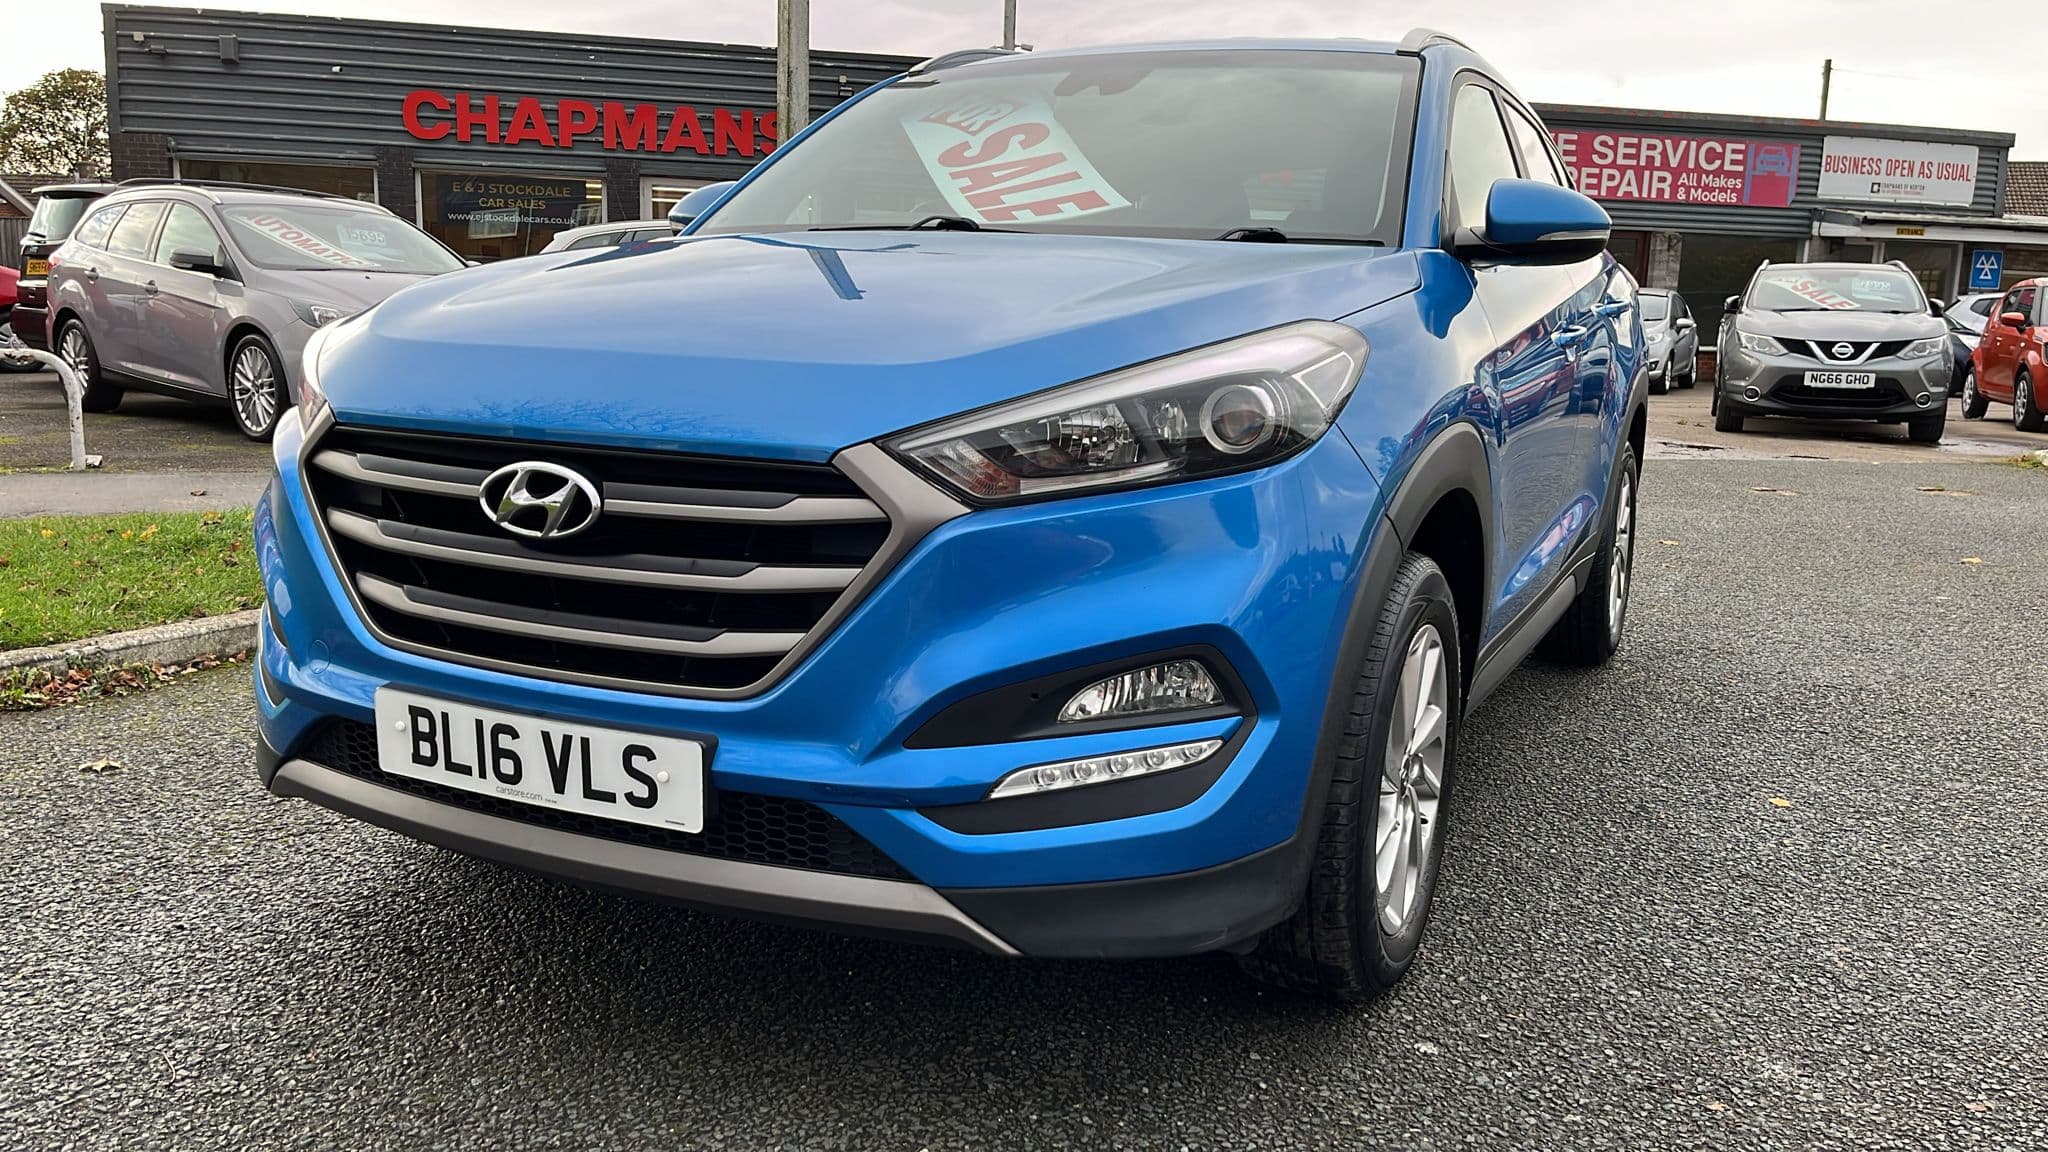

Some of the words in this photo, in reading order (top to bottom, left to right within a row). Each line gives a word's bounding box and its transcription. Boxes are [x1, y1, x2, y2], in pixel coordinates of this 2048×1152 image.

[1551, 133, 1578, 162] E
[1592, 135, 1745, 173] SERVICE
[938, 122, 1110, 222] SALE
[1824, 155, 1881, 176] BUSINESS
[1886, 159, 1914, 178] OPEN
[1918, 161, 1933, 179] AS
[1937, 162, 1971, 182] USUAL
[1678, 173, 1697, 187] All
[1701, 174, 1742, 189] Makes
[453, 182, 460, 192] E
[464, 182, 474, 192] &
[478, 183, 484, 193] J
[489, 184, 571, 197] STOCKDALE
[1677, 187, 1687, 200] &
[1690, 188, 1737, 203] Models
[479, 198, 504, 208] CAR
[508, 199, 546, 210] SALES
[448, 213, 577, 225] www.ejstockdalecars.co.uk
[1792, 280, 1853, 309] SALE
[1810, 373, 1842, 385] NG66
[1845, 374, 1870, 385] GHO
[408, 704, 523, 786] BL16
[540, 729, 658, 809] VLS
[496, 785, 543, 801] carstore.com
